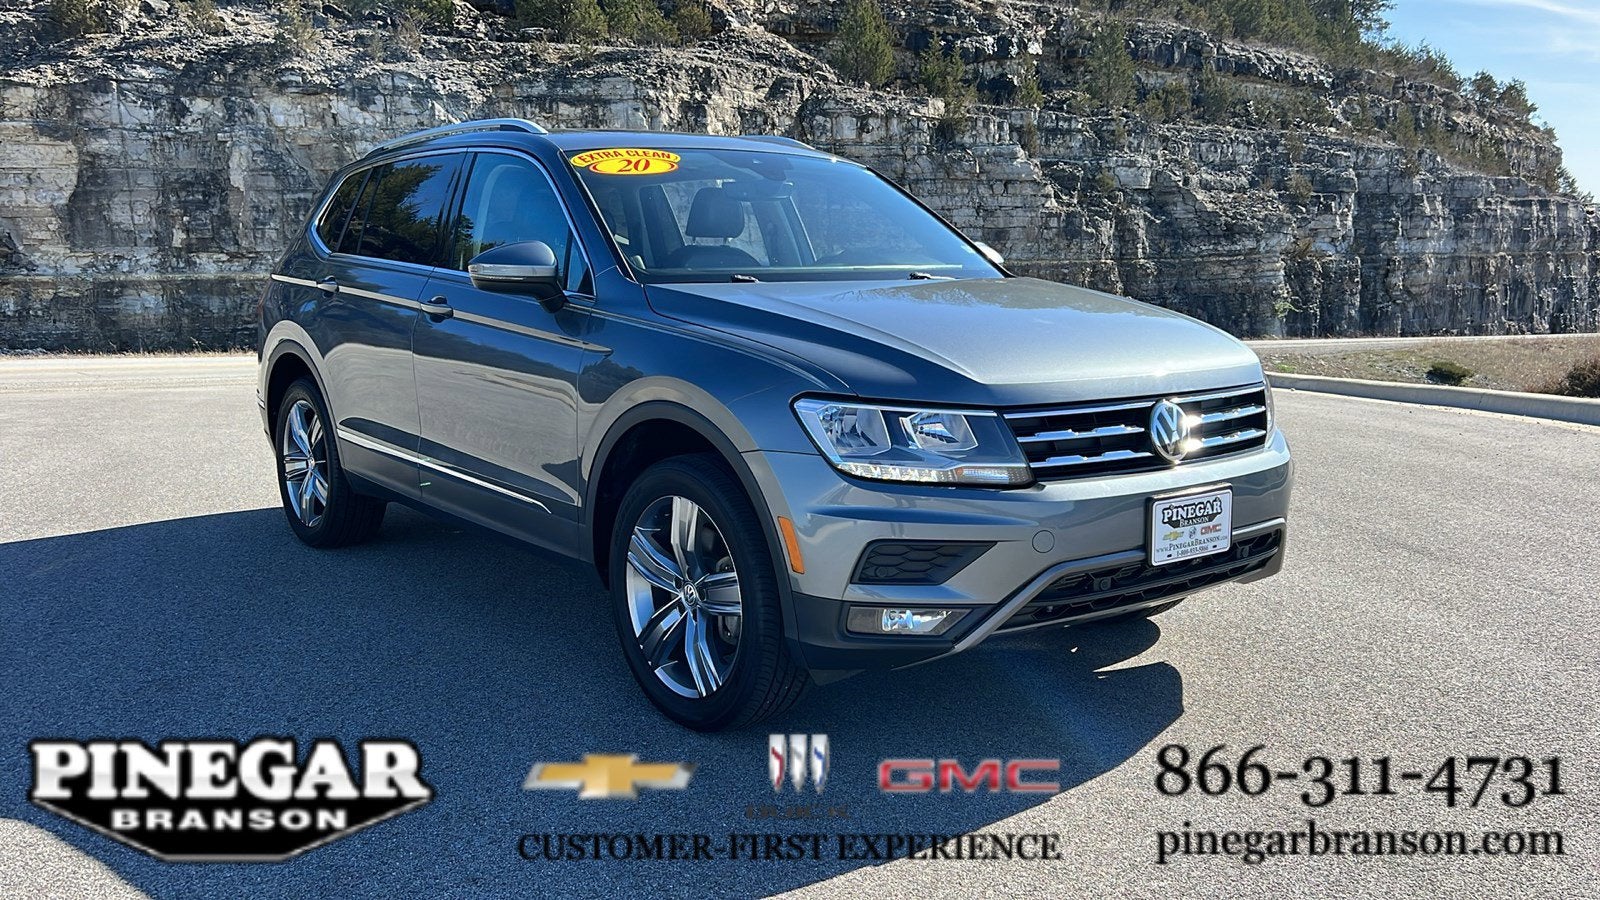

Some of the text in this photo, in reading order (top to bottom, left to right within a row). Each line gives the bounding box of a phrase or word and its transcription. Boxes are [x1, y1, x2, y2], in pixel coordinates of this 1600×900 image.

[578, 150, 671, 163] EXTRA CLEAN
[617, 158, 651, 172] 20
[1162, 499, 1222, 523] PINEGAR
[1201, 524, 1221, 535] GMC
